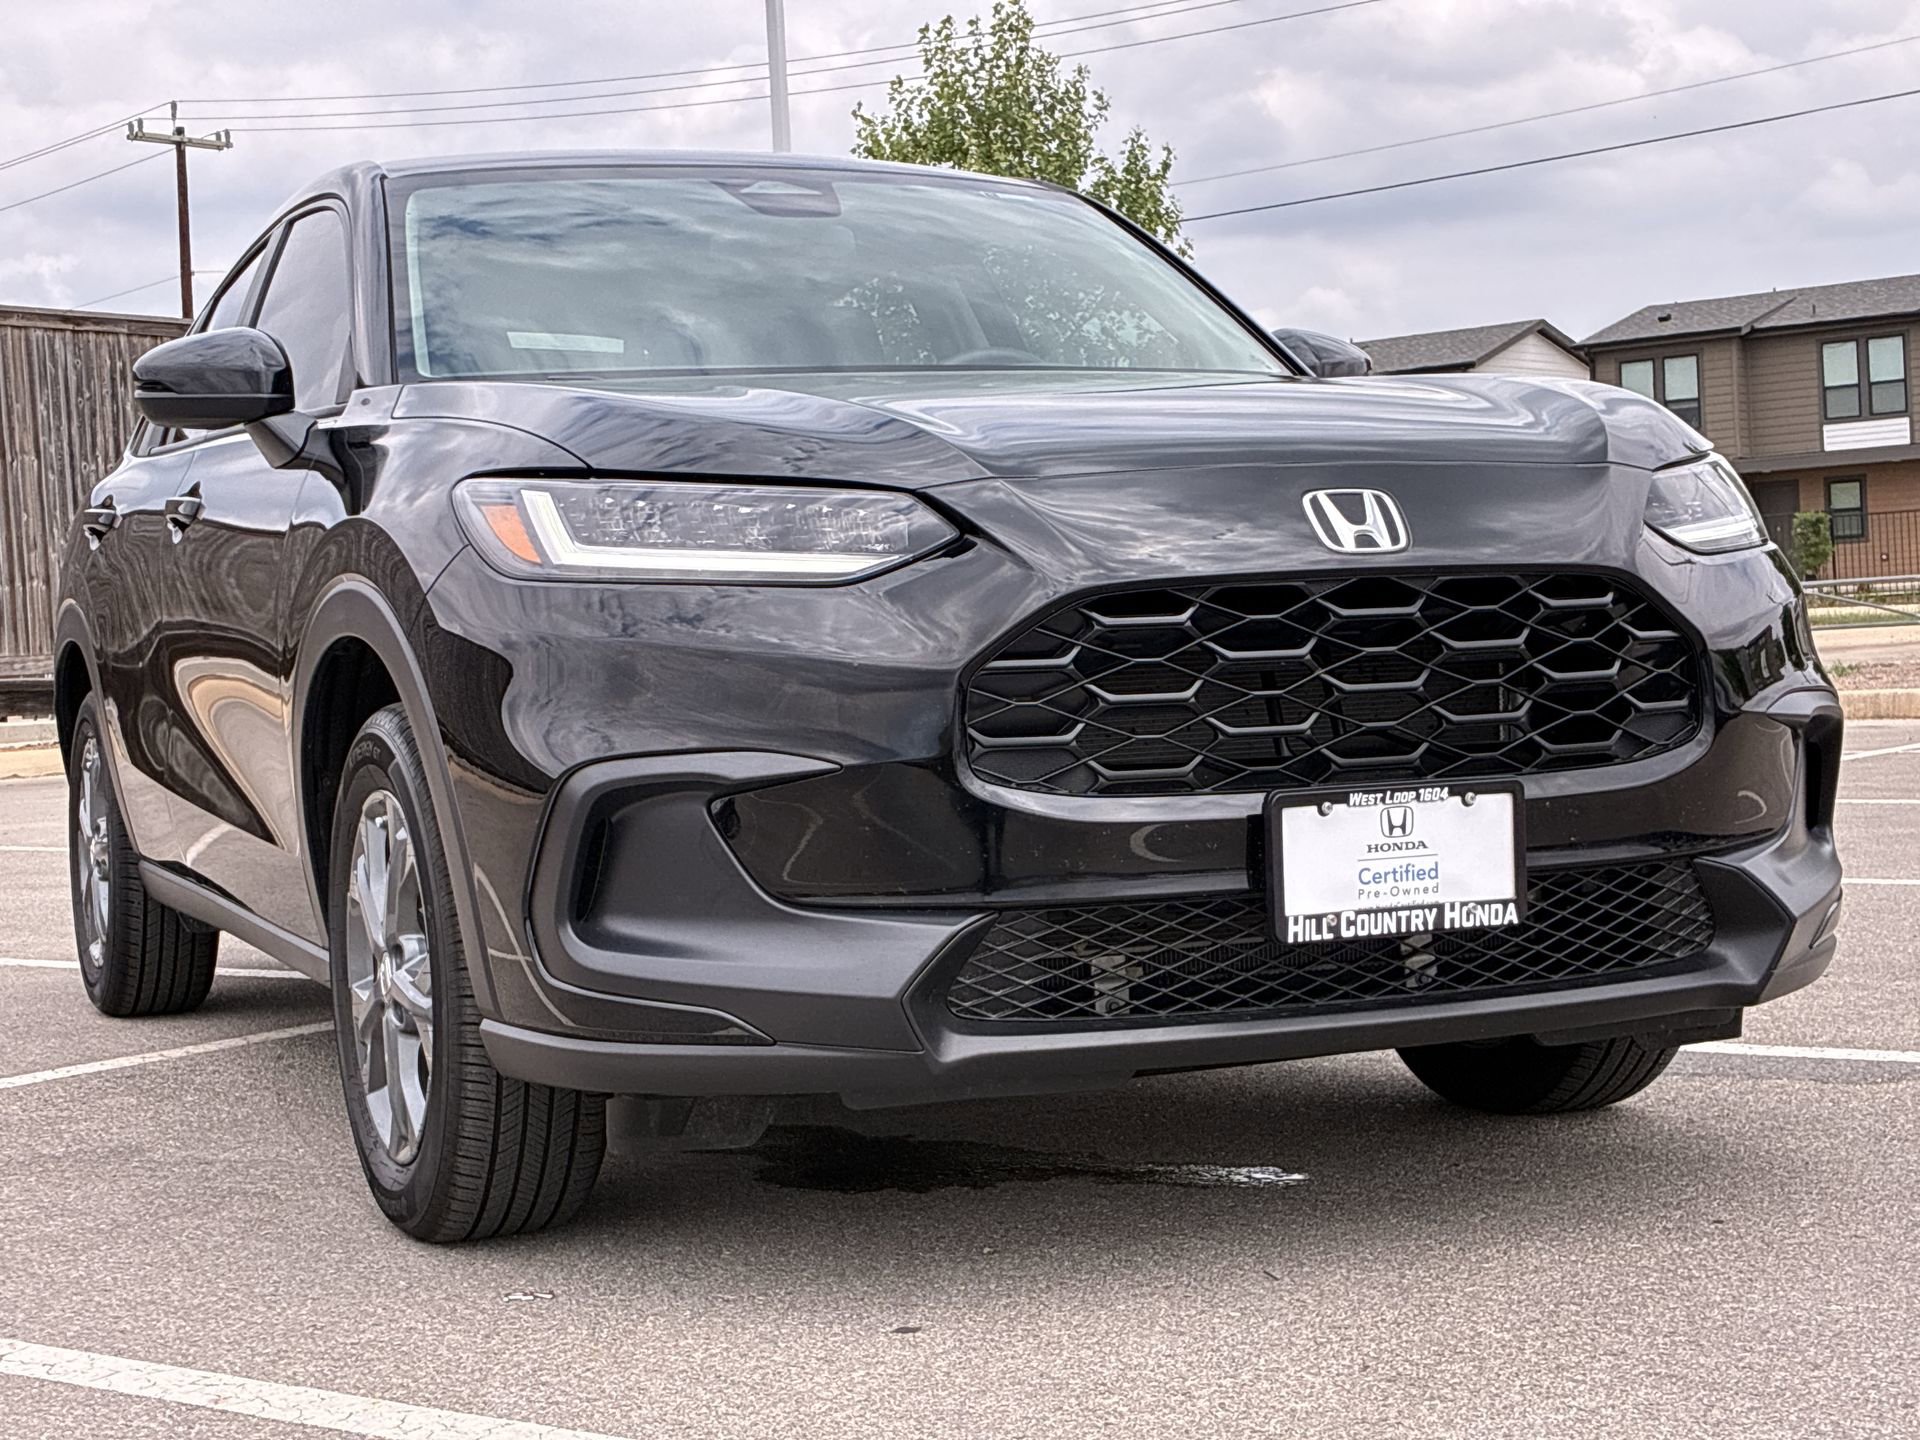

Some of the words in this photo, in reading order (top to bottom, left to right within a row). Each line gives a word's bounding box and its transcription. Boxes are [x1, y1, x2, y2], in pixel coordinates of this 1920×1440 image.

[1349, 792, 1383, 806] WEST
[1385, 790, 1416, 804] LOOP
[1418, 787, 1449, 802] 1604
[1366, 840, 1429, 853] HONDA
[1358, 861, 1439, 885] Certified
[1358, 882, 1439, 899] Pre-Owned
[1287, 915, 1334, 943] HILL
[1340, 908, 1438, 938] COUNTRY
[1444, 901, 1519, 929] HONDA
